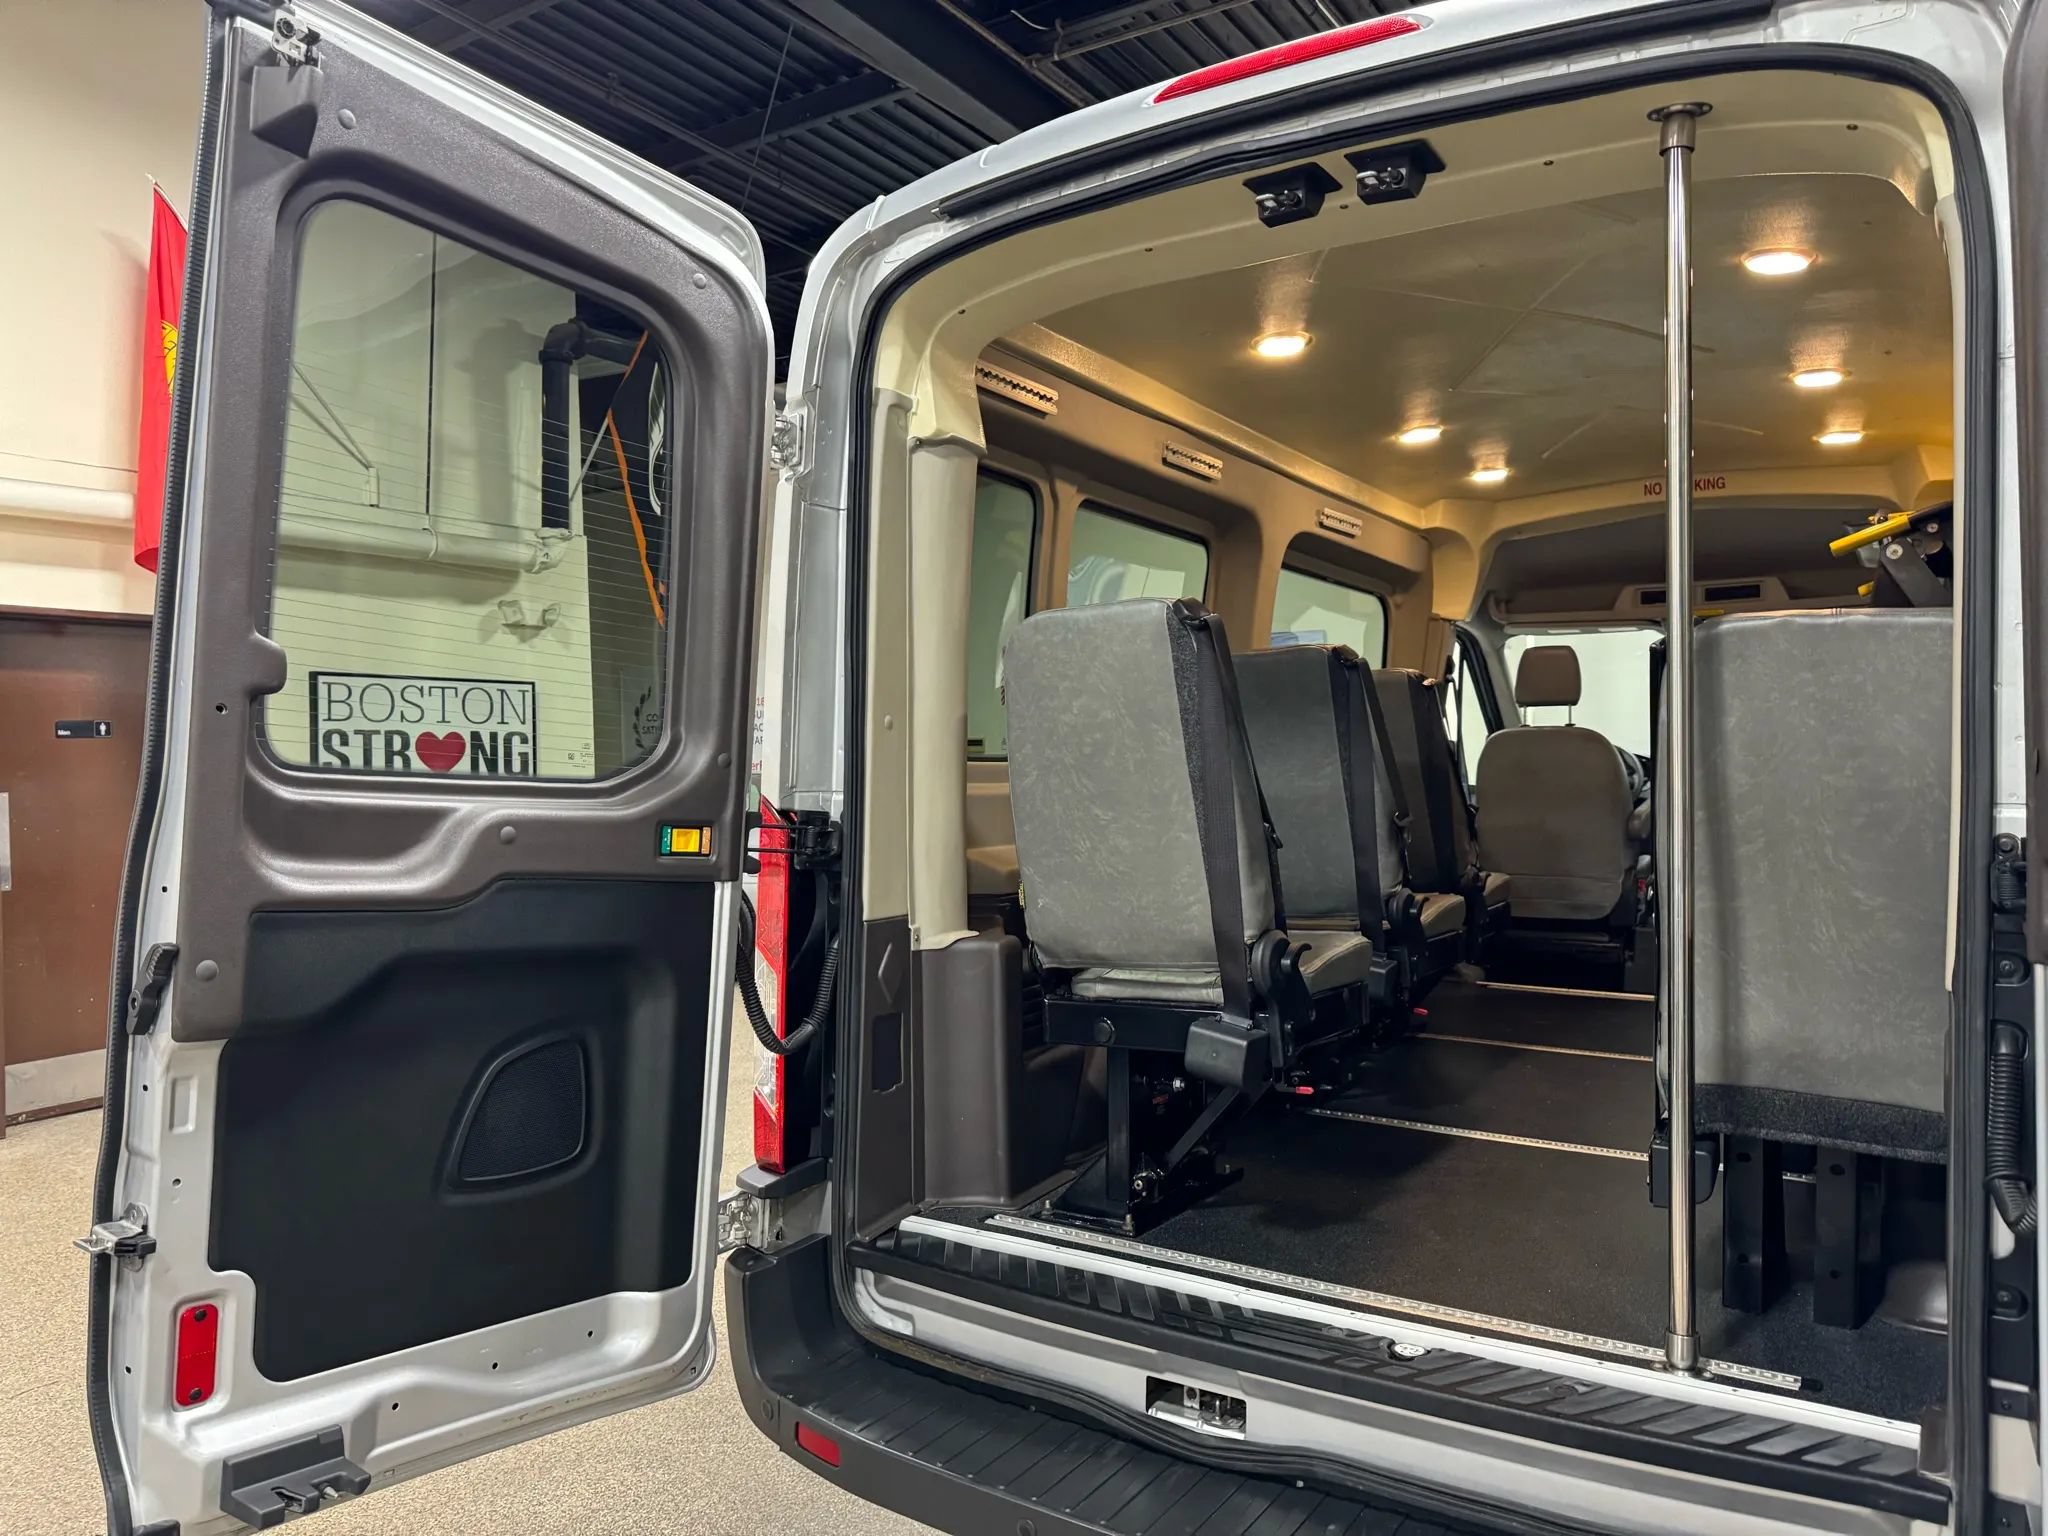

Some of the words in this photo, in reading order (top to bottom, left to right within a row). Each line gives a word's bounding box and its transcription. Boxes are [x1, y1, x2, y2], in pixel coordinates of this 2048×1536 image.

[1644, 483, 1662, 496] NO
[1694, 476, 1726, 491] KING
[322, 681, 529, 725] BOSTON
[322, 728, 529, 776] STRNG
